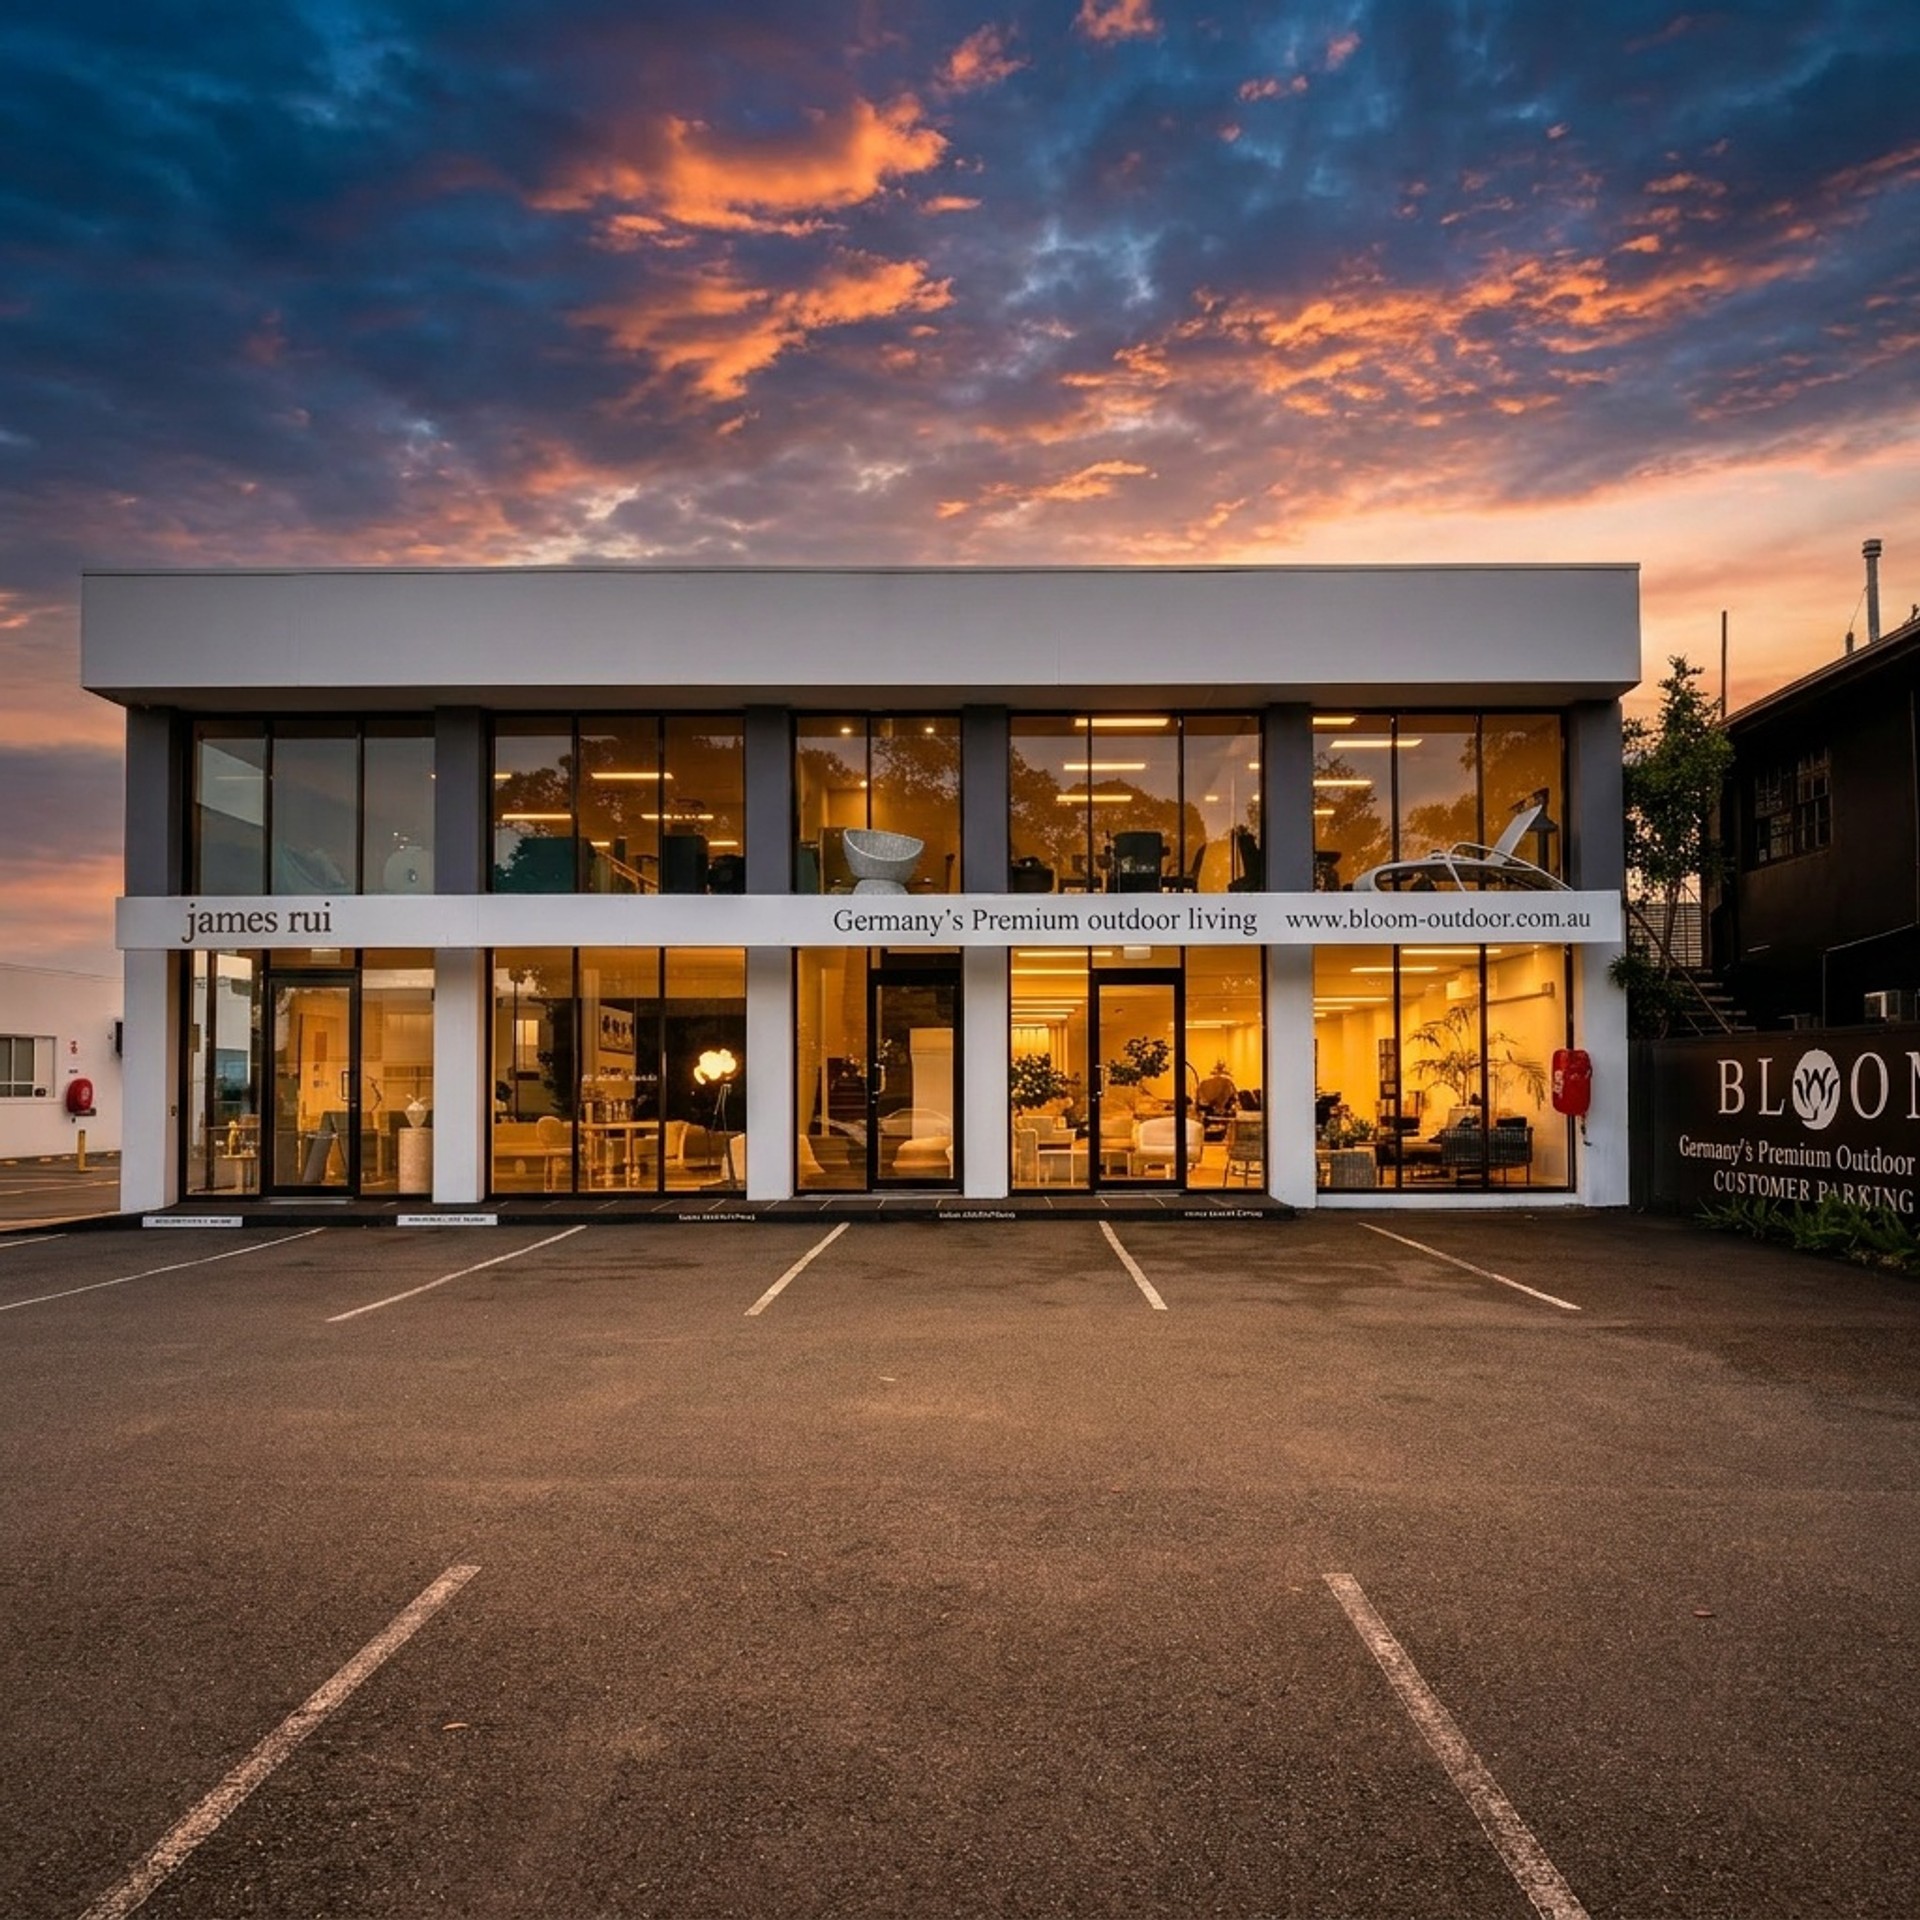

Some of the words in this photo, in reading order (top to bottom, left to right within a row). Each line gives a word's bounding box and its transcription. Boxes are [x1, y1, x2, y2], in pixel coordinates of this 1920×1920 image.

[180, 902, 278, 944] james
[287, 901, 332, 933] rui
[833, 908, 964, 937] Germany's
[973, 907, 1079, 931] Premium
[1087, 907, 1181, 930] outdoor
[1189, 907, 1258, 937] living
[1285, 907, 1591, 929] www.bloom-outdoor.com.au
[1679, 1134, 1753, 1166] Germany's
[1758, 1140, 1831, 1168] Premium
[1836, 1145, 1915, 1176] Outdoor
[1713, 1169, 1811, 1201] CUSTOMER
